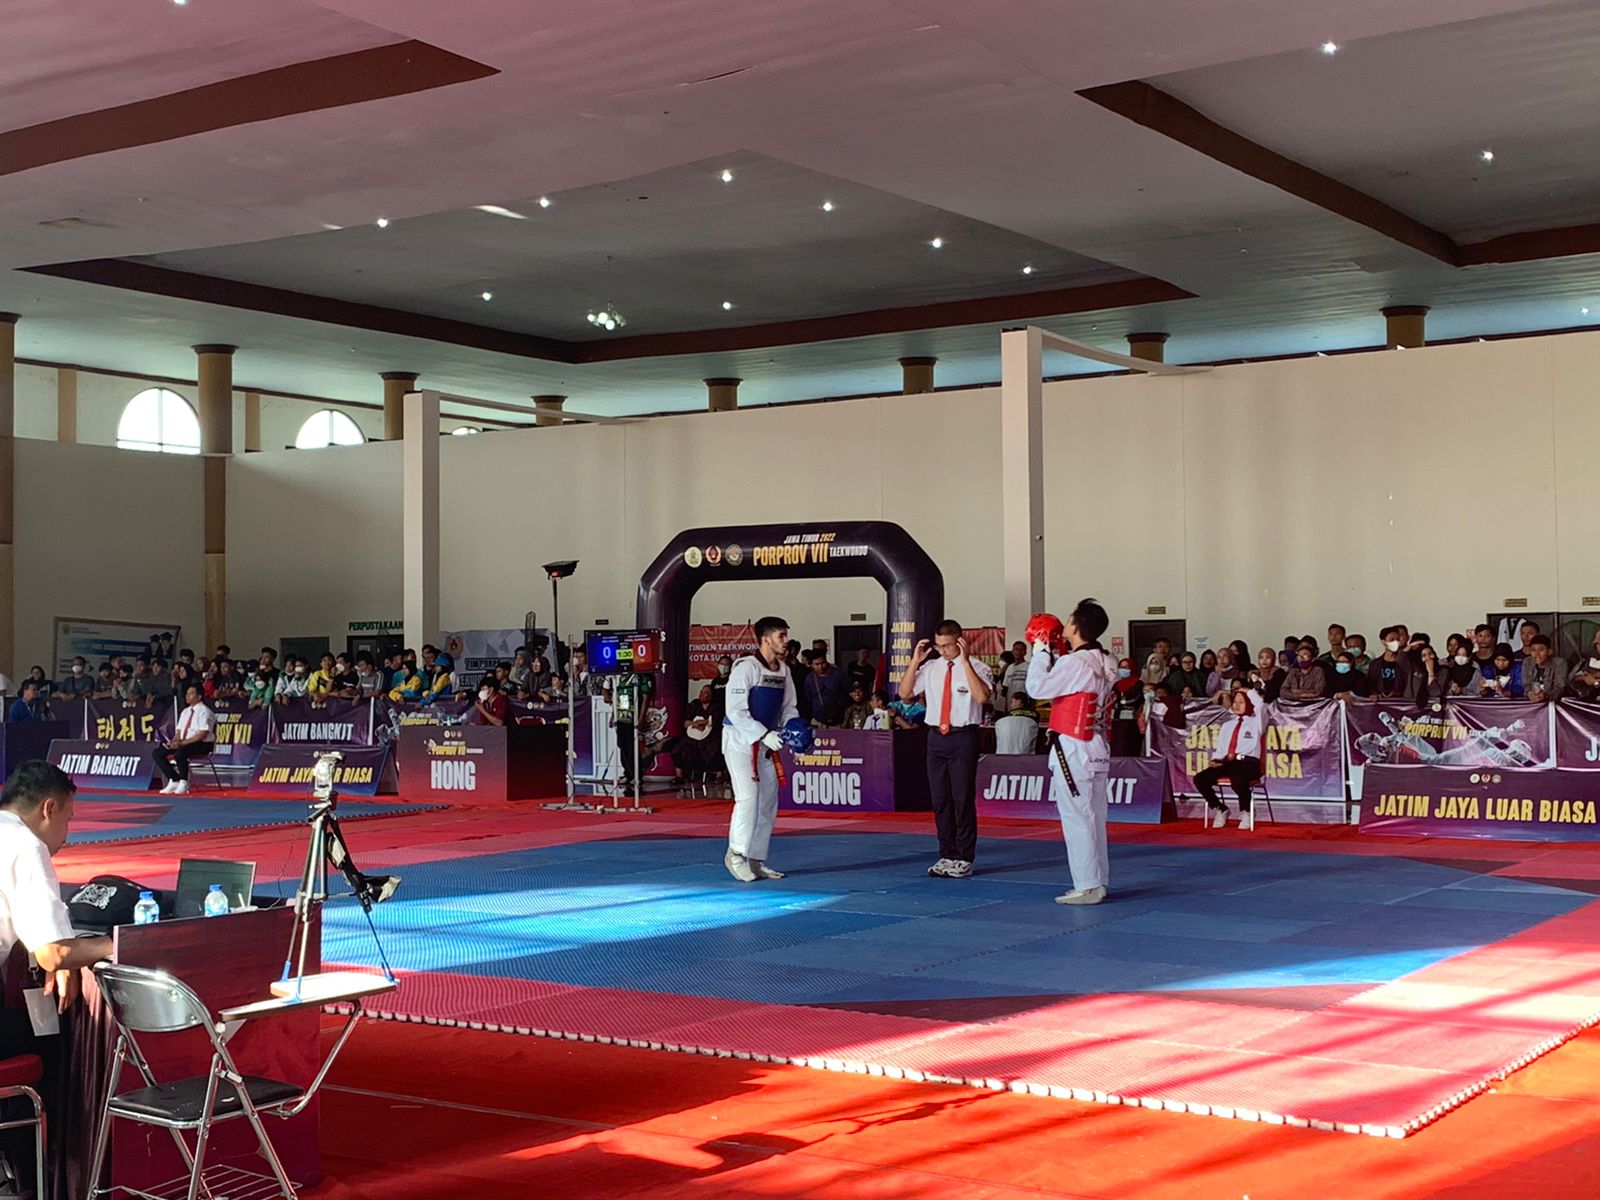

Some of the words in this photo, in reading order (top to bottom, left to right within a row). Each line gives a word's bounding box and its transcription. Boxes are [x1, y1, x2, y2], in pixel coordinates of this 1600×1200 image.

[753, 544, 808, 566] PORPROV
[811, 543, 829, 563] VII
[829, 545, 869, 557] TAEKWONDO
[891, 622, 915, 632] JATIM
[718, 643, 759, 651] TAEKWON
[234, 724, 252, 744] VII
[282, 723, 309, 740] JATIM
[310, 723, 353, 741] BANGKIT
[1266, 725, 1302, 750] AYA
[57, 754, 91, 775] JATIM
[90, 755, 141, 776] BANGKIT
[259, 768, 290, 783] JATIM
[290, 768, 313, 783] JAYA
[342, 768, 374, 784] BIASA
[431, 760, 477, 790] HONG
[1266, 753, 1303, 778] ASA
[792, 771, 861, 806] CHONG
[983, 775, 1044, 801] JATIM
[1374, 794, 1430, 817] JATIM
[1434, 796, 1480, 819] JAYA
[1485, 798, 1533, 822] LUAR
[1538, 800, 1597, 824] BIASA
